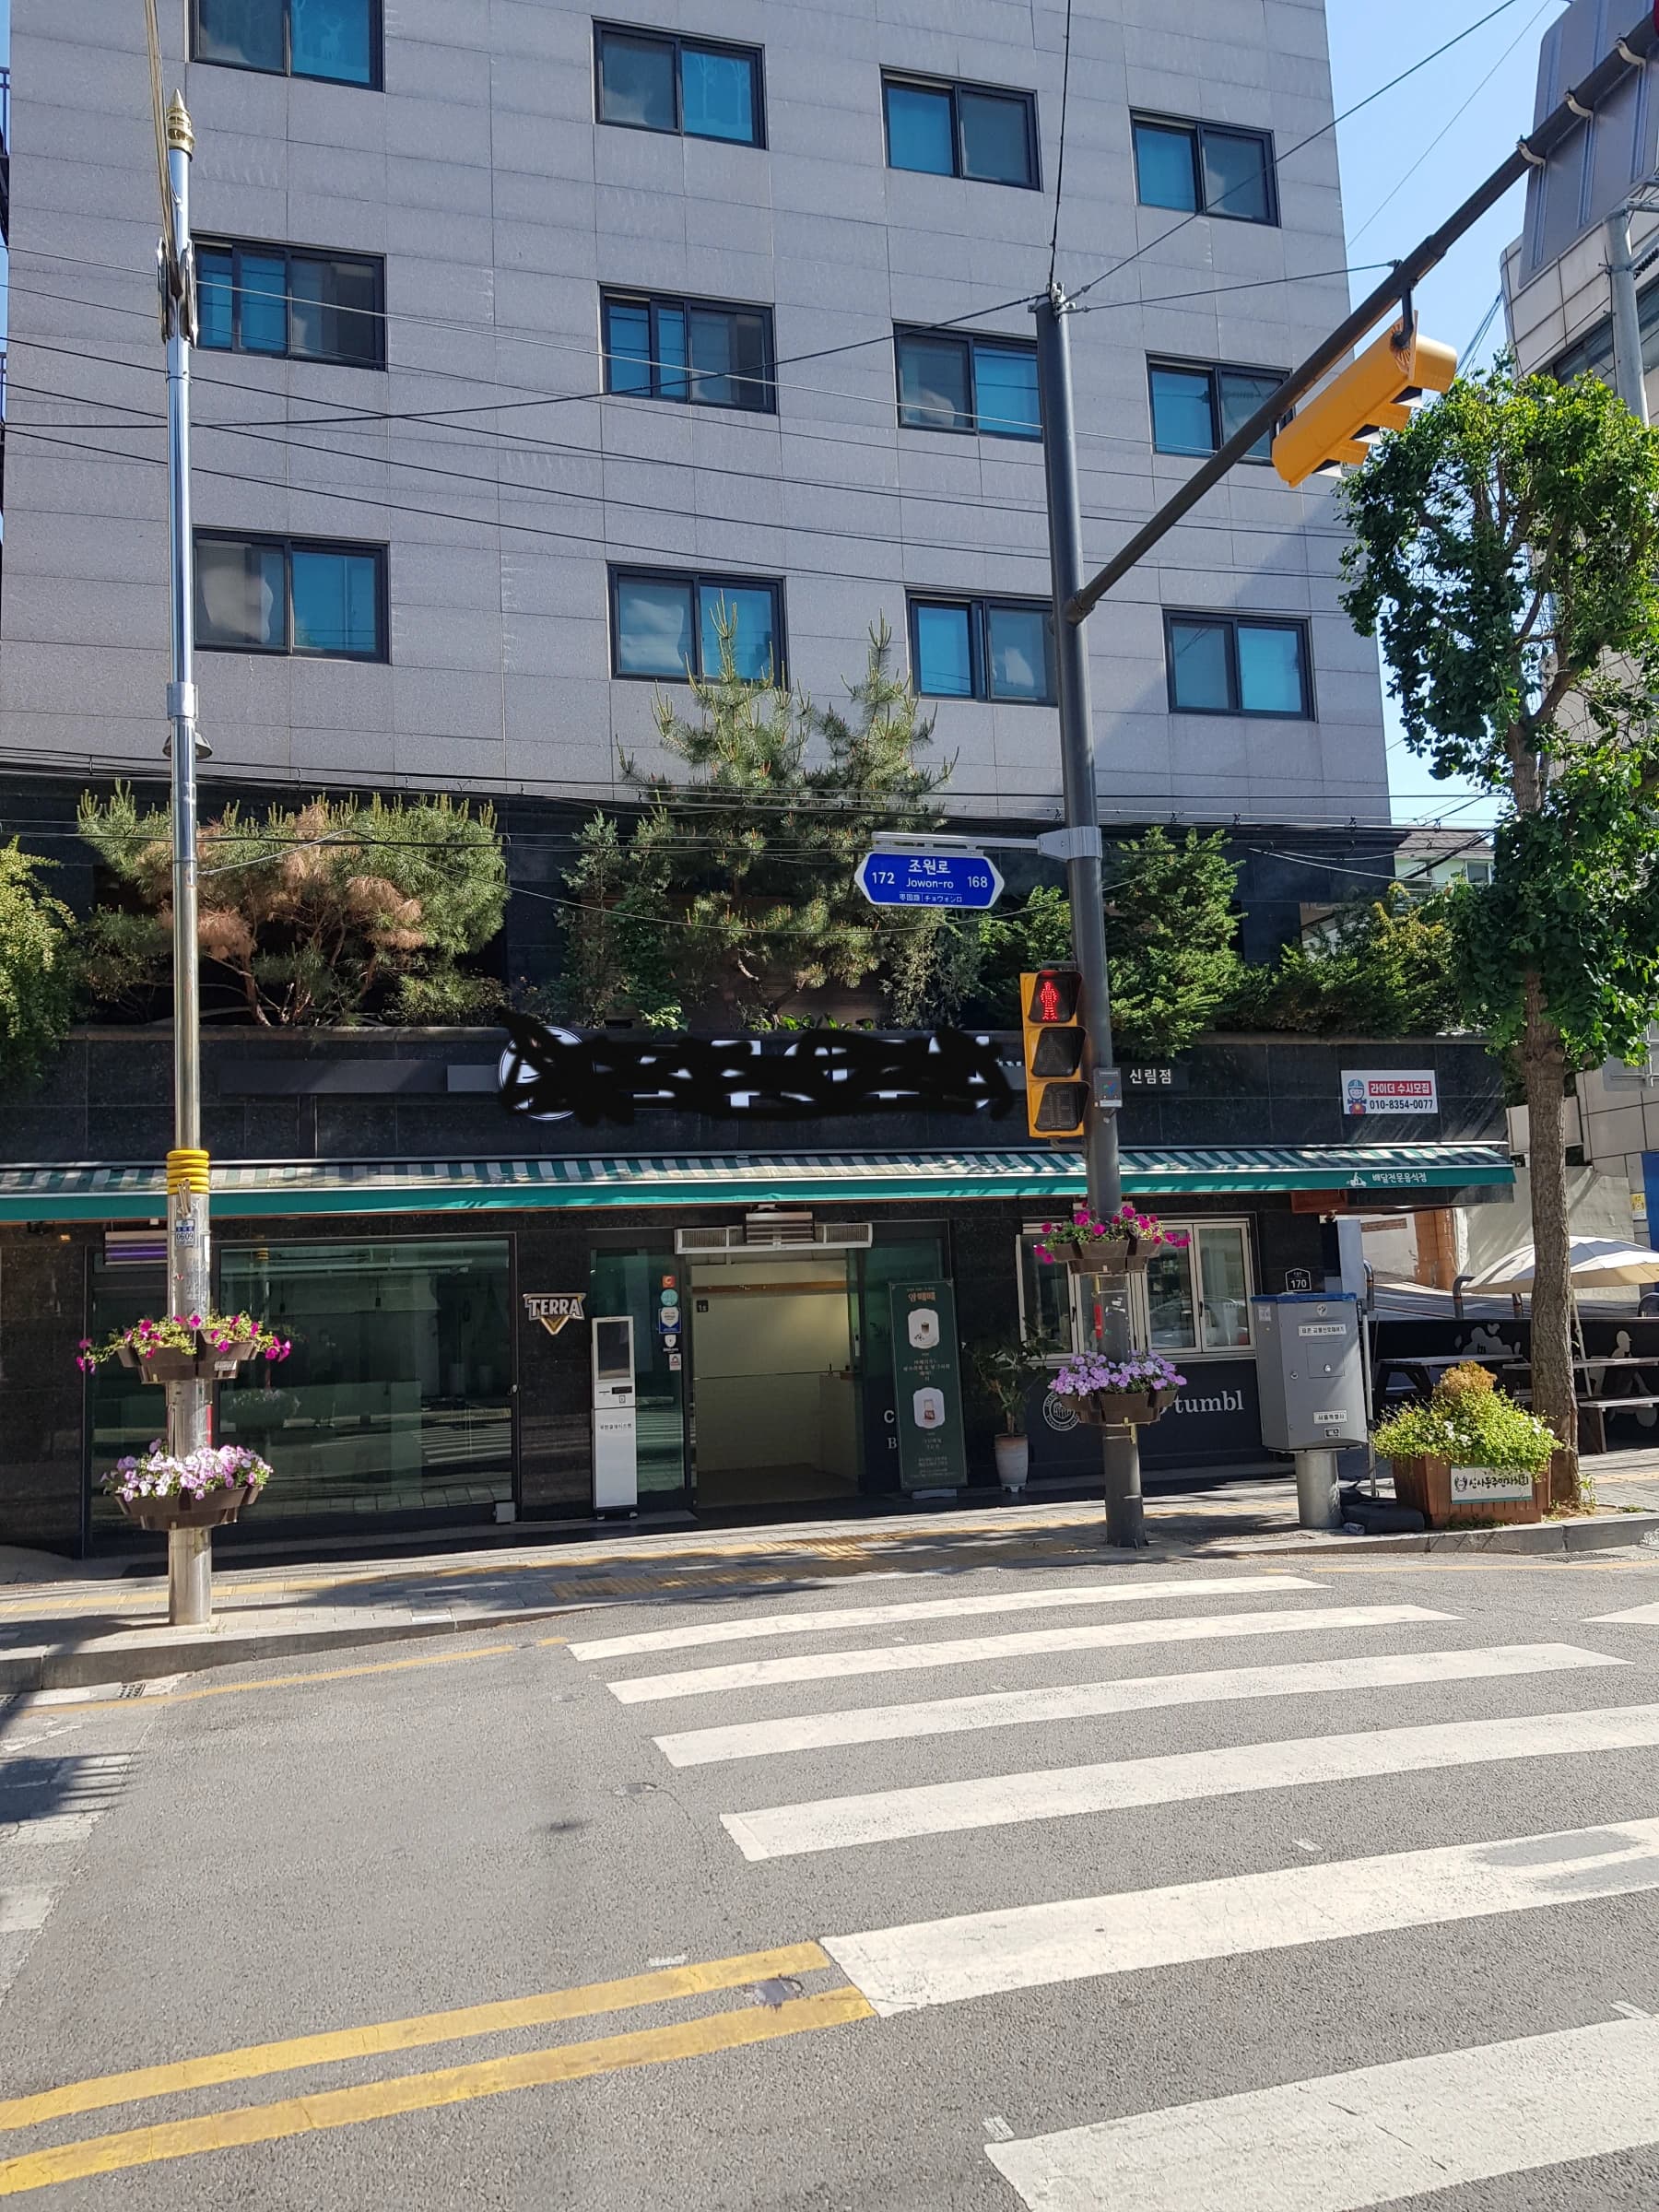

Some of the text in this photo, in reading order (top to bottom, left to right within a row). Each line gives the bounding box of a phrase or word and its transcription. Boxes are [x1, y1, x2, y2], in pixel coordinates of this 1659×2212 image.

[908, 859, 951, 876] 조원로
[872, 872, 895, 885] 172
[906, 877, 954, 889] Jowon-ro
[967, 876, 988, 888] 168
[1129, 1068, 1171, 1085] 신림점
[1371, 1082, 1430, 1094] 라이더 수시모집
[1370, 1099, 1433, 1110] 010-8354-0077
[1371, 1171, 1428, 1183] 배달전문음식점
[1290, 1278, 1307, 1288] 170
[528, 1299, 582, 1317] TERRA
[1173, 1390, 1244, 1414] tumbl
